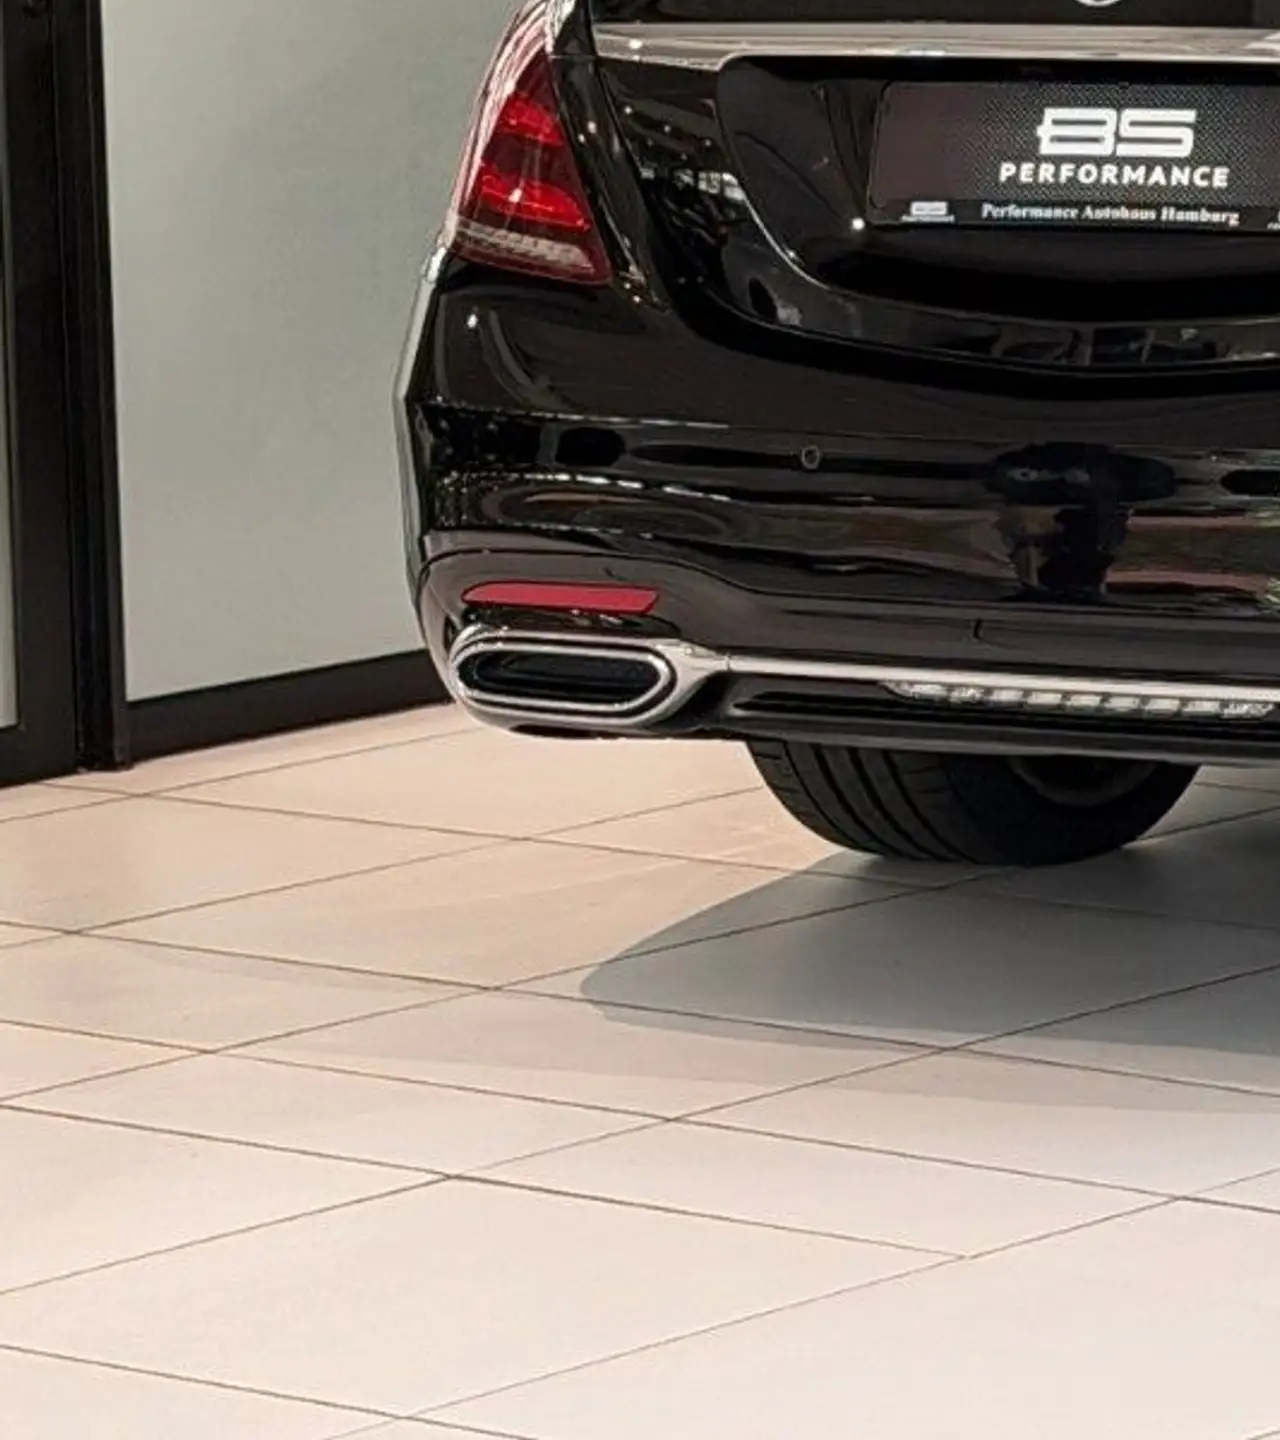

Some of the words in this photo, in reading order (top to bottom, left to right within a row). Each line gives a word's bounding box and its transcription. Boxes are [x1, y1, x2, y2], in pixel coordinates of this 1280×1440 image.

[1000, 162, 1230, 188] PERFORMANCE
[981, 202, 1079, 220] Performance
[1080, 205, 1157, 221] Autohaus
[1160, 206, 1240, 227] Hamburg
